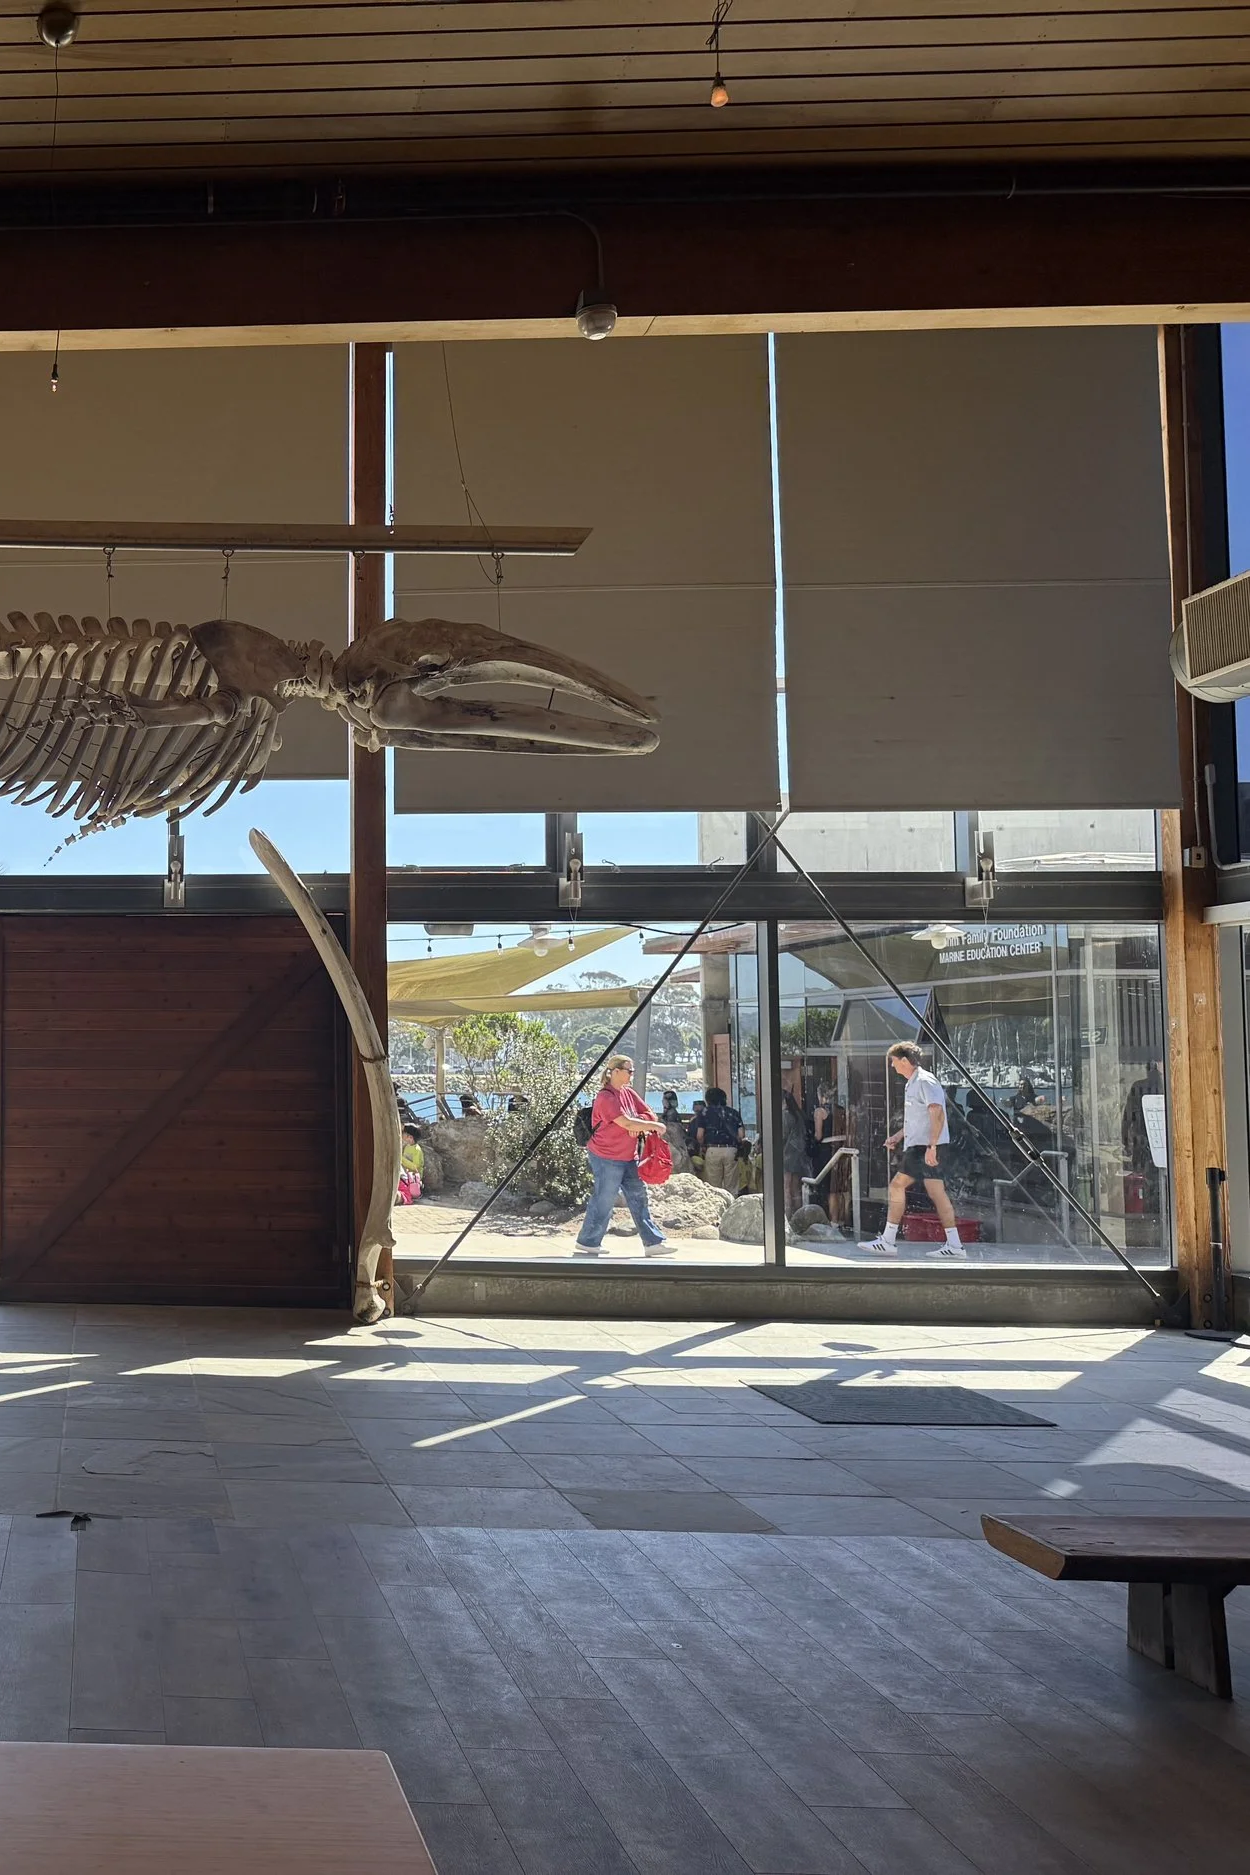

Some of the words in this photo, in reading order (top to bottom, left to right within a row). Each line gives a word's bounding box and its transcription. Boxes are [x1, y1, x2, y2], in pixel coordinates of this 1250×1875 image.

[962, 929, 988, 946] Family
[993, 924, 1043, 941] Foundation
[939, 950, 965, 964] MARINE
[967, 945, 1007, 961] EDUCATION
[1009, 941, 1041, 957] CENTER
